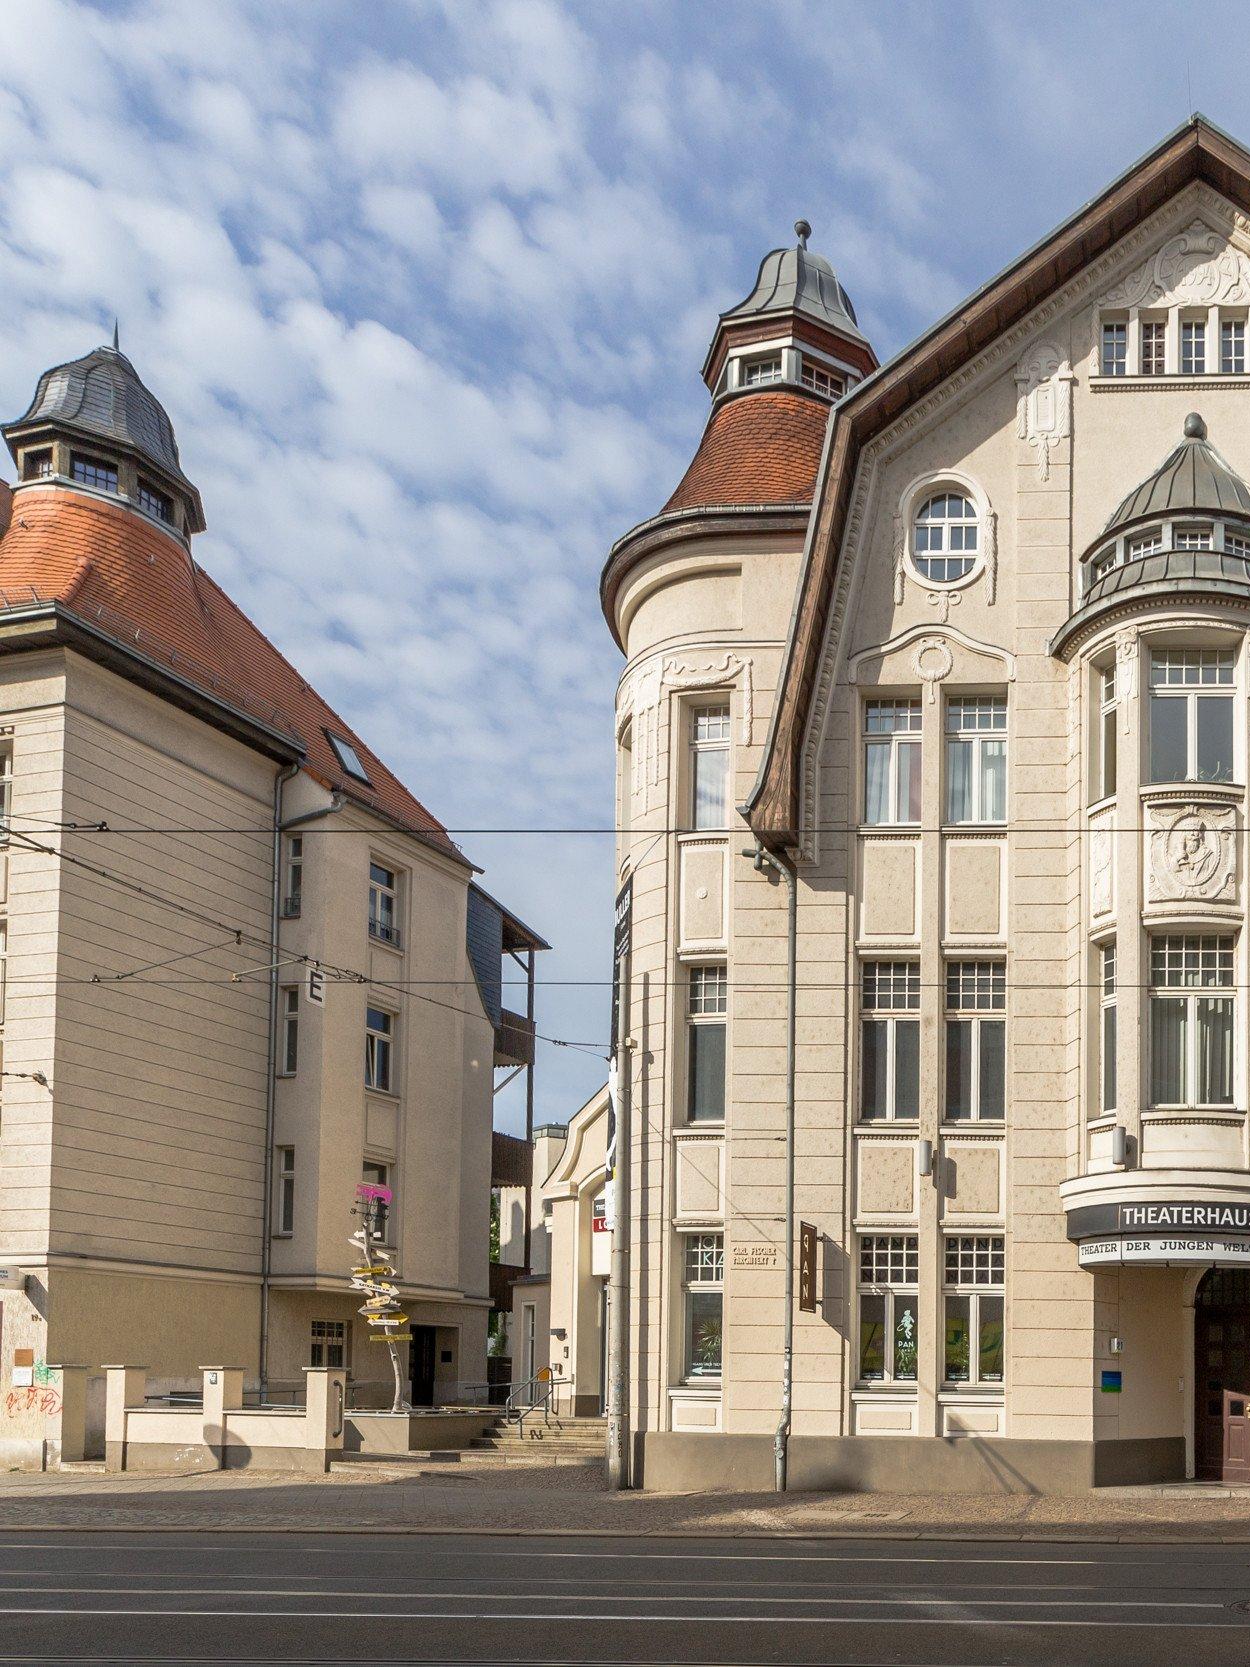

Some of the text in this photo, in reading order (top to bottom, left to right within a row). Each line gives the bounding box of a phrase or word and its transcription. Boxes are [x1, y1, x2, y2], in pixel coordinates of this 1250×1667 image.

[310, 970, 323, 1003] E
[1081, 1242, 1118, 1256] THEATER
[1125, 1241, 1151, 1251] DER
[1160, 1241, 1215, 1251] JUNGEN
[898, 1340, 914, 1348] PAN
